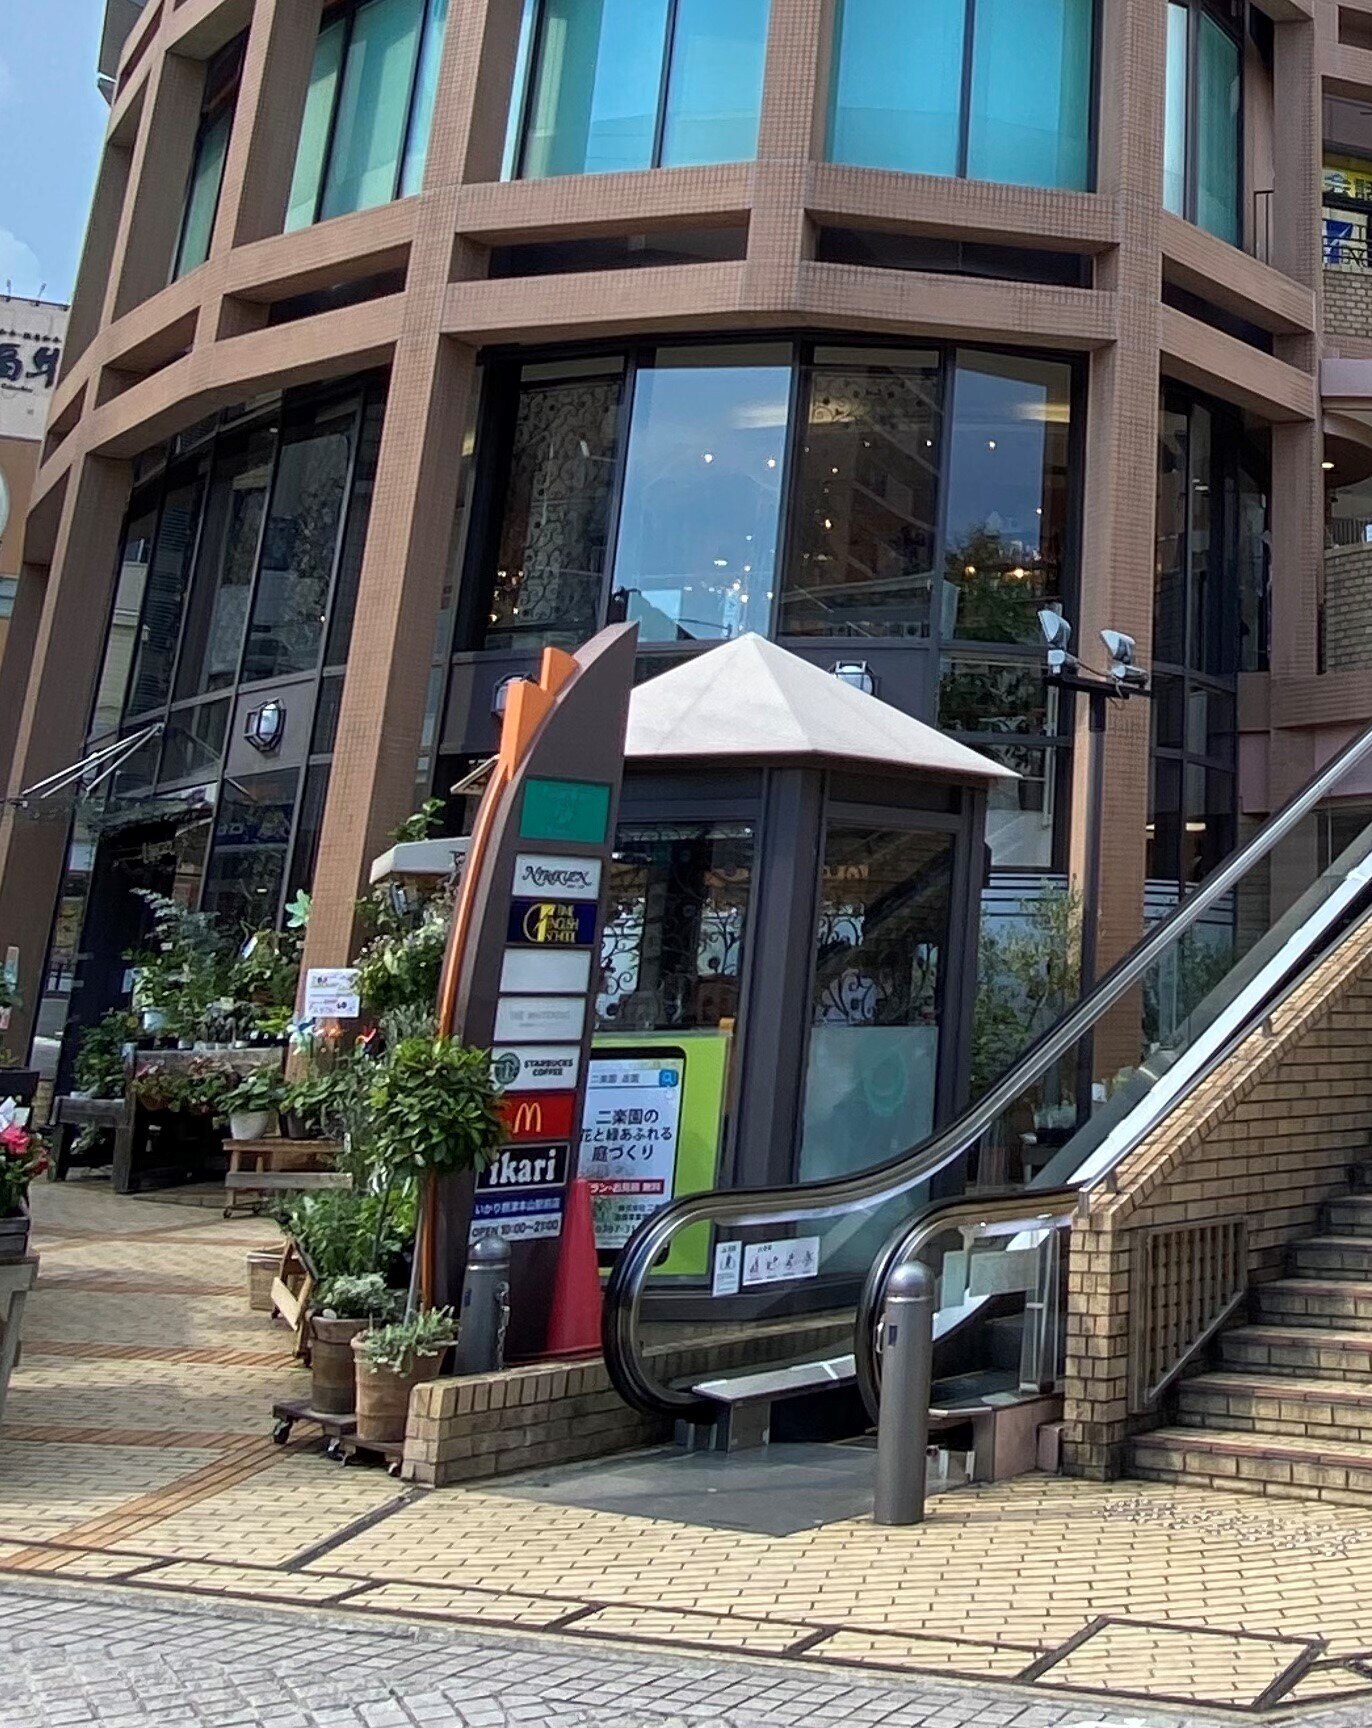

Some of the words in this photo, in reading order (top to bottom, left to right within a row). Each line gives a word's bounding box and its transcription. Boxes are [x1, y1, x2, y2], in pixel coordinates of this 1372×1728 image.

[524, 1058, 574, 1069] STARBUCKS
[532, 1068, 564, 1077] COFFEE
[596, 1108, 660, 1125] 二楽園の
[592, 1144, 654, 1162] 庭づくり
[489, 1149, 557, 1185] ikari
[472, 1226, 499, 1238] OPEN
